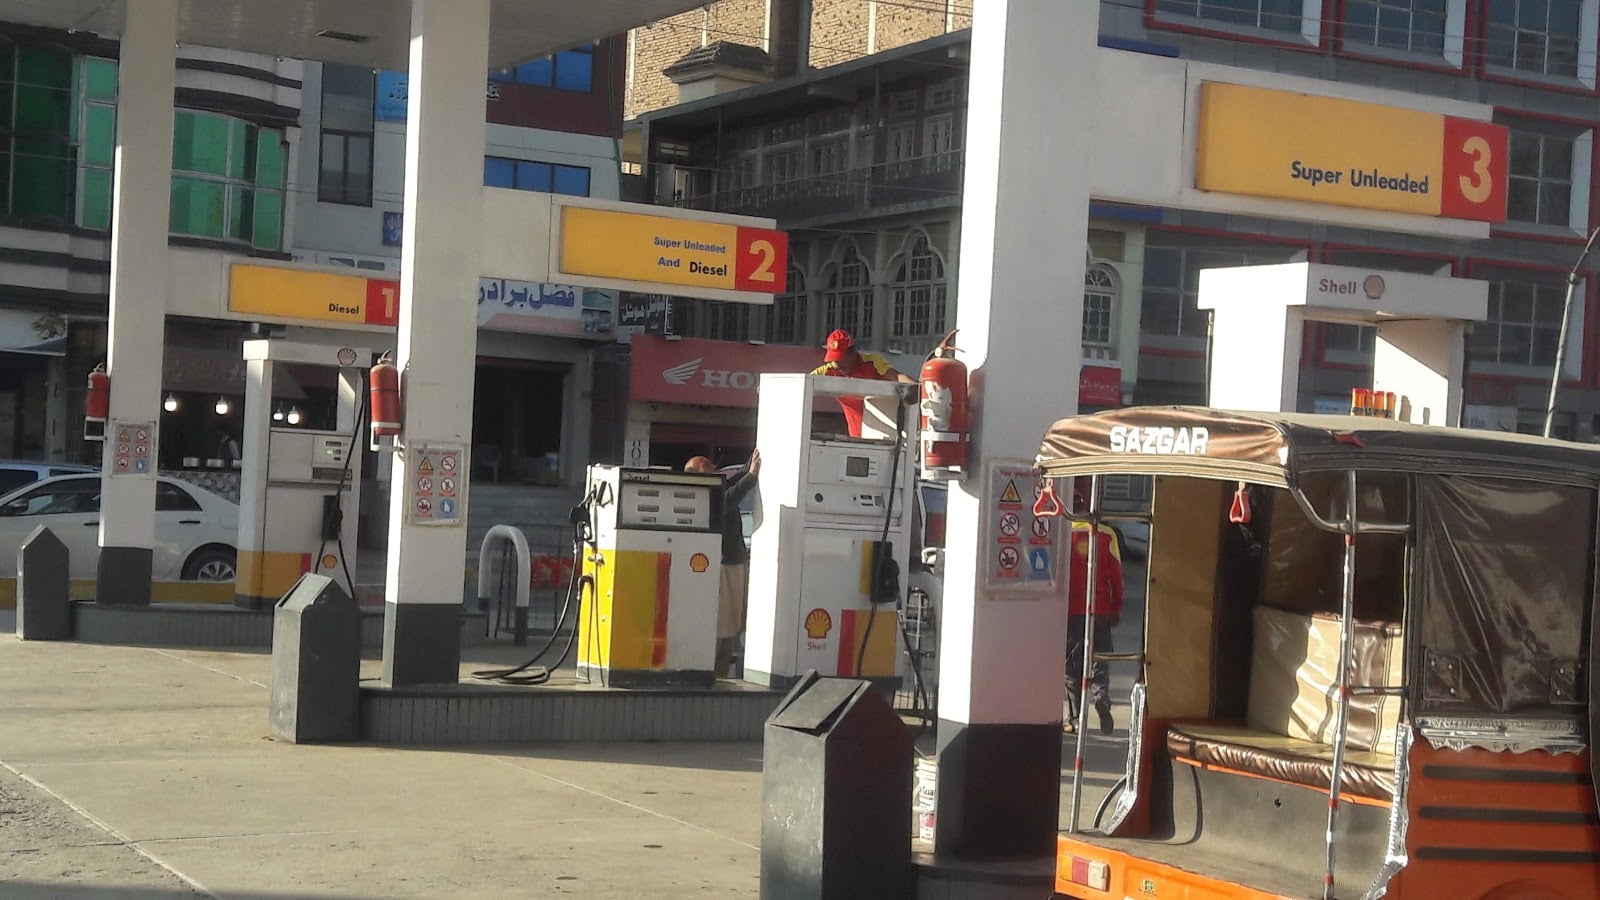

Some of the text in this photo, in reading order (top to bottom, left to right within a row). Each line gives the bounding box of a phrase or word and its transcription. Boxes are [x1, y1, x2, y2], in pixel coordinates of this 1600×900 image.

[1291, 160, 1429, 194] Super Unleaded
[1459, 136, 1492, 203] 3
[654, 236, 726, 254] Super Unleaded
[657, 256, 727, 277] And Diesel
[748, 239, 775, 283] 2
[1318, 278, 1357, 295] Shell
[328, 303, 359, 315] Diesel
[381, 287, 394, 319] 1
[702, 369, 760, 389] HO
[1109, 425, 1209, 456] SAZGAR
[807, 641, 827, 651] Shell
